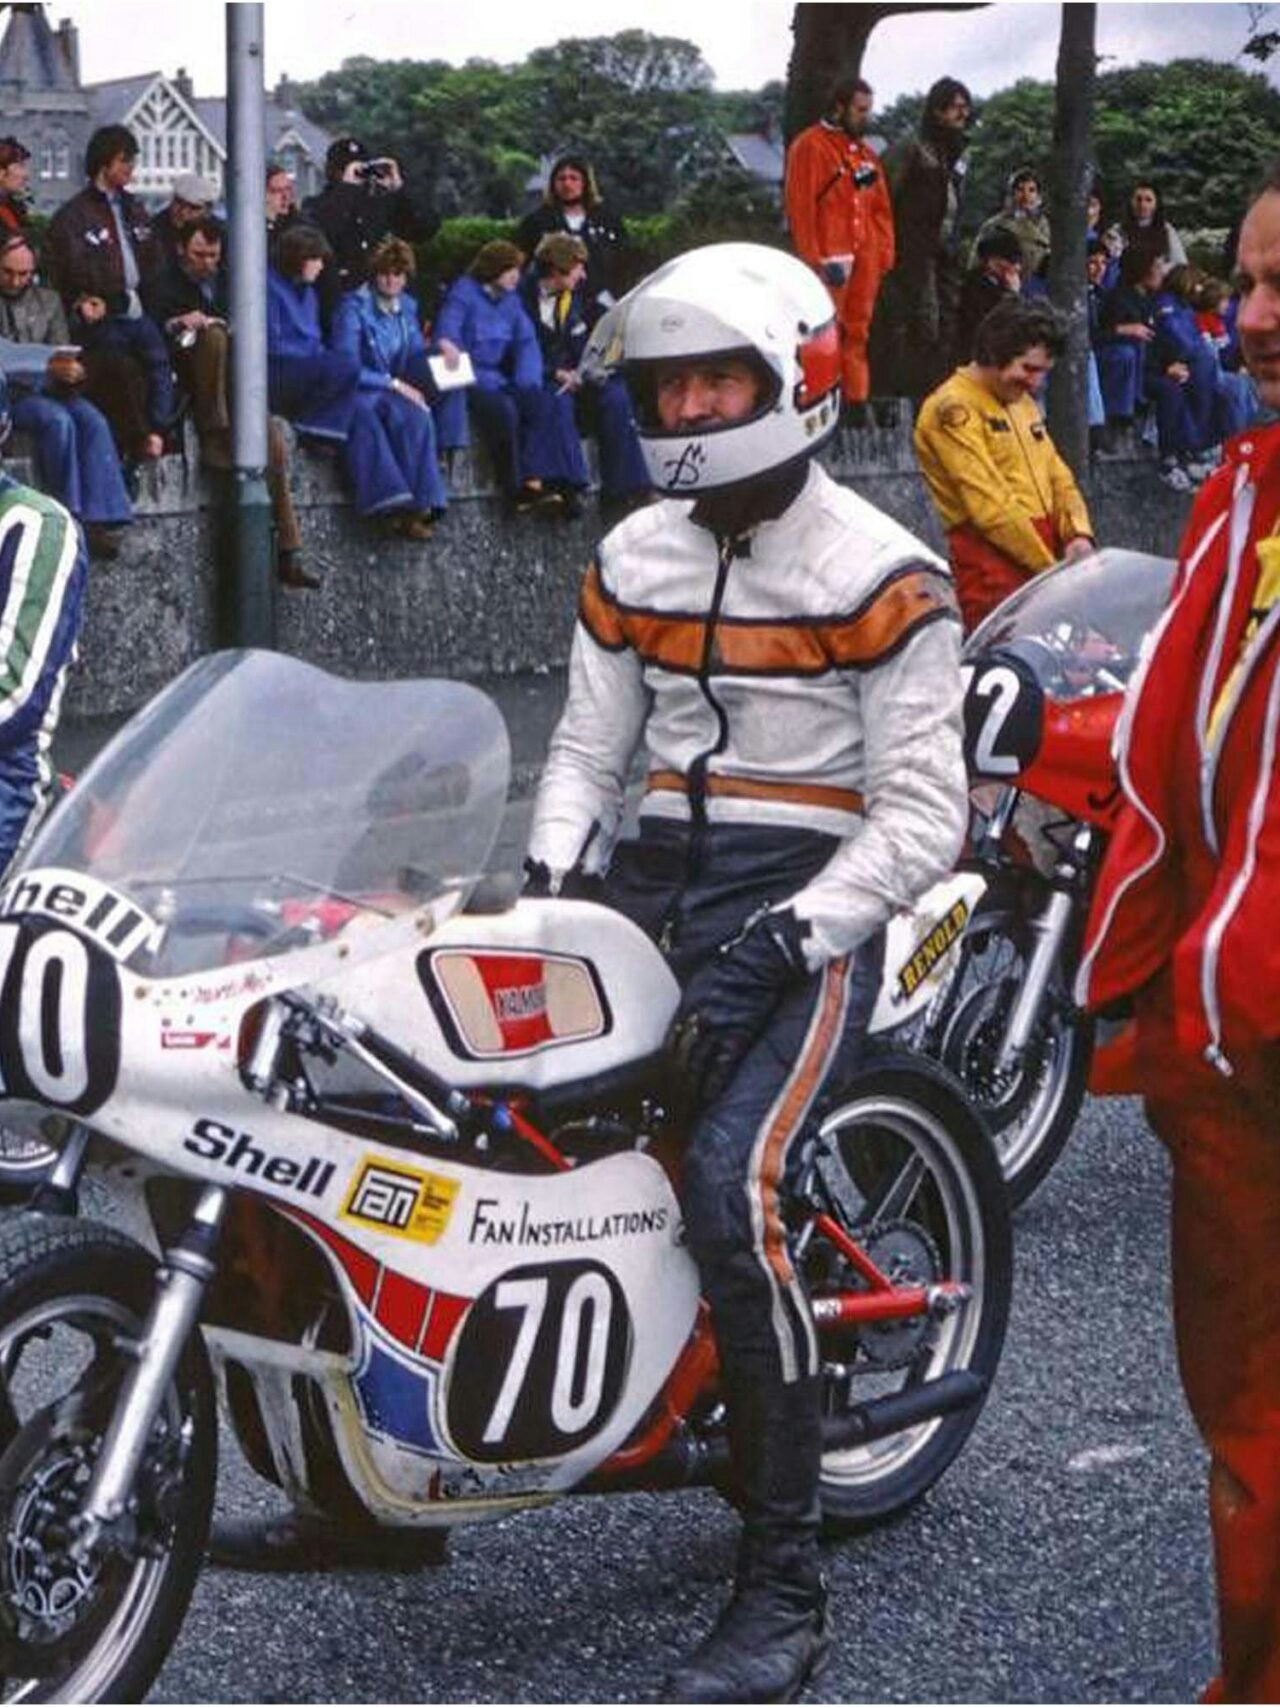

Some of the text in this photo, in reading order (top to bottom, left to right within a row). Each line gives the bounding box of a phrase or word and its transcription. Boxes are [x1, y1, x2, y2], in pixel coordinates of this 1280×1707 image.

[901, 902, 968, 994] RENOLD
[183, 1117, 337, 1198] Shell
[481, 1270, 613, 1443] 70
